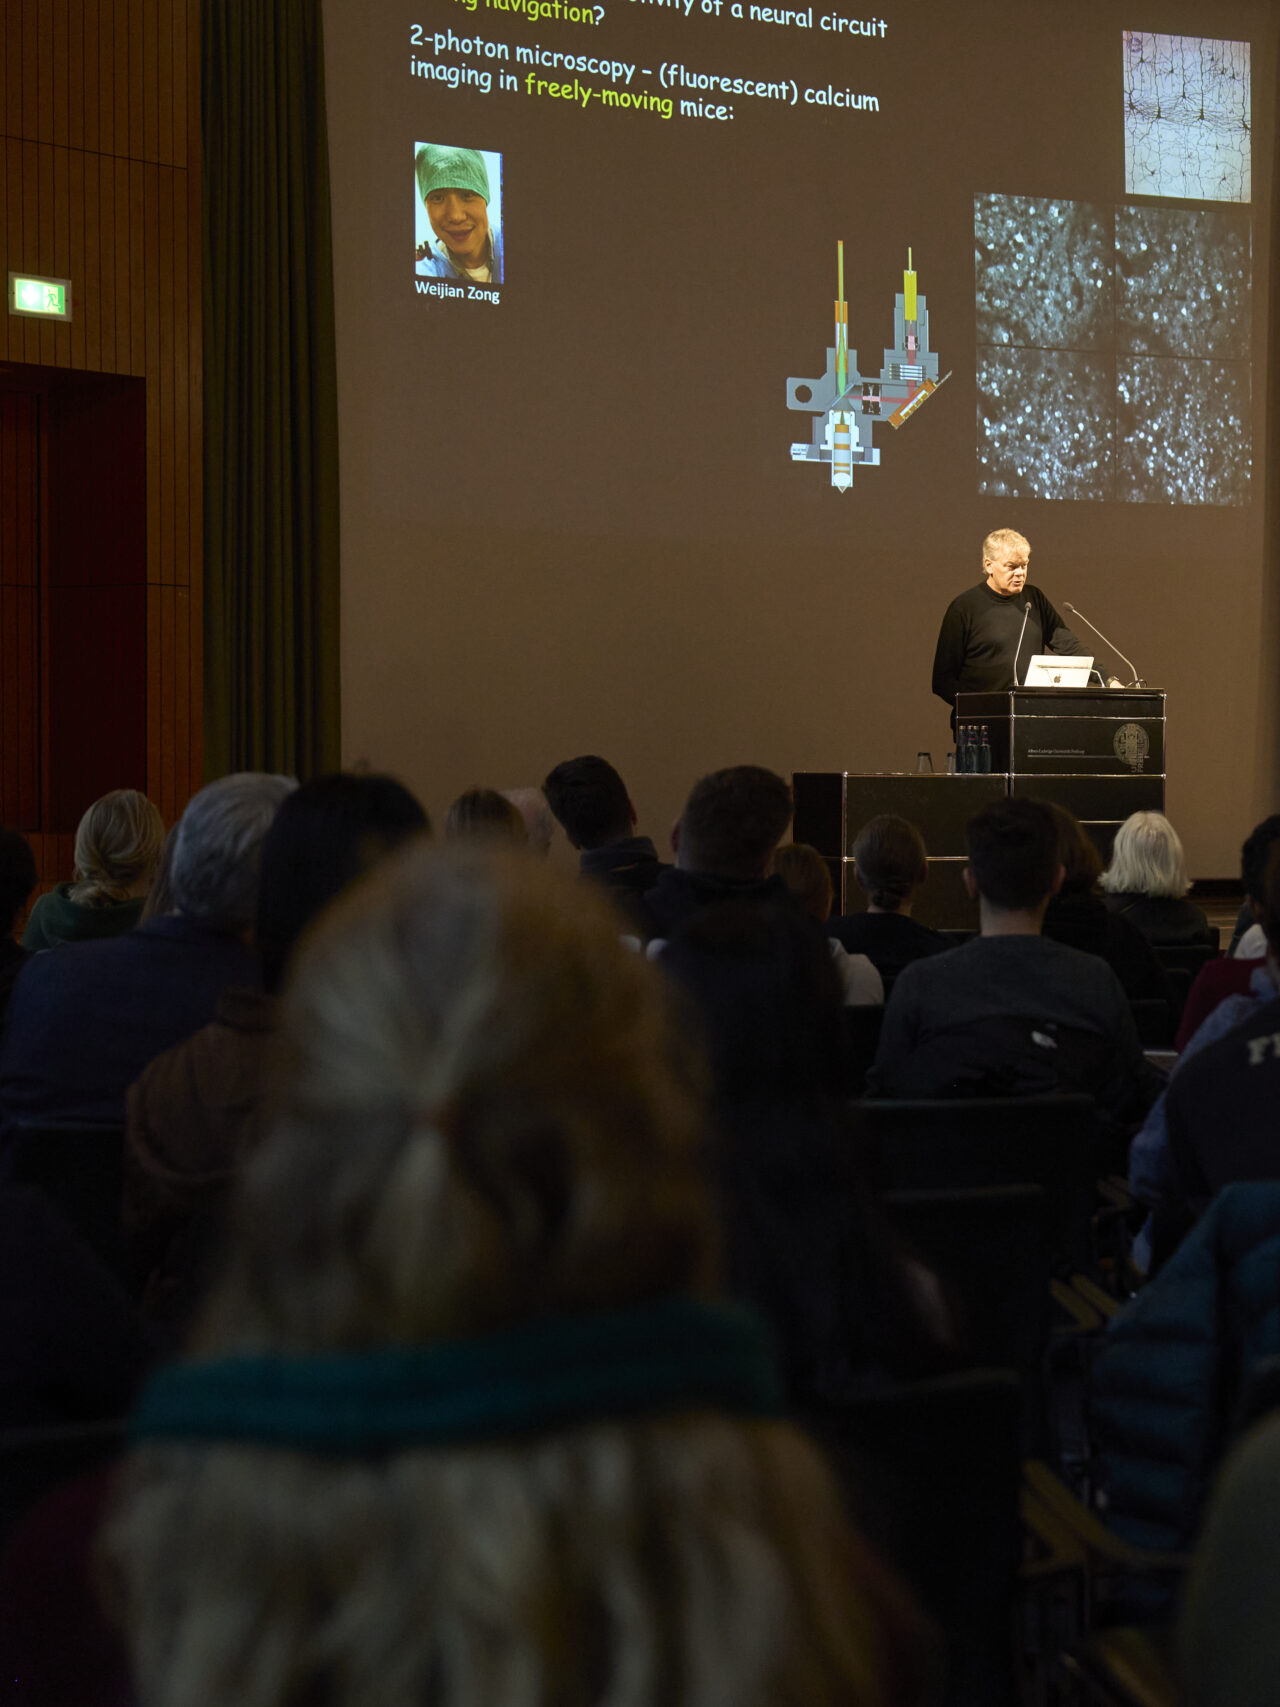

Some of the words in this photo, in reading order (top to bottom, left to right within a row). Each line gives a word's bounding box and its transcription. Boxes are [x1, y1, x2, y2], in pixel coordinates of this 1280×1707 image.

[701, 0, 724, 16] of
[731, 3, 743, 18] a
[750, 5, 812, 28] neural
[820, 12, 888, 38] circuit
[410, 24, 509, 60] 2-photon
[516, 44, 635, 84] microscopy
[659, 62, 798, 105] (fluorescent)
[804, 84, 880, 112] calcium
[411, 55, 492, 93] imaging
[500, 69, 518, 92] in
[525, 72, 673, 119] freely-moving
[680, 98, 734, 120] mice:
[415, 280, 464, 299] Weijian
[467, 286, 500, 304] Zong
